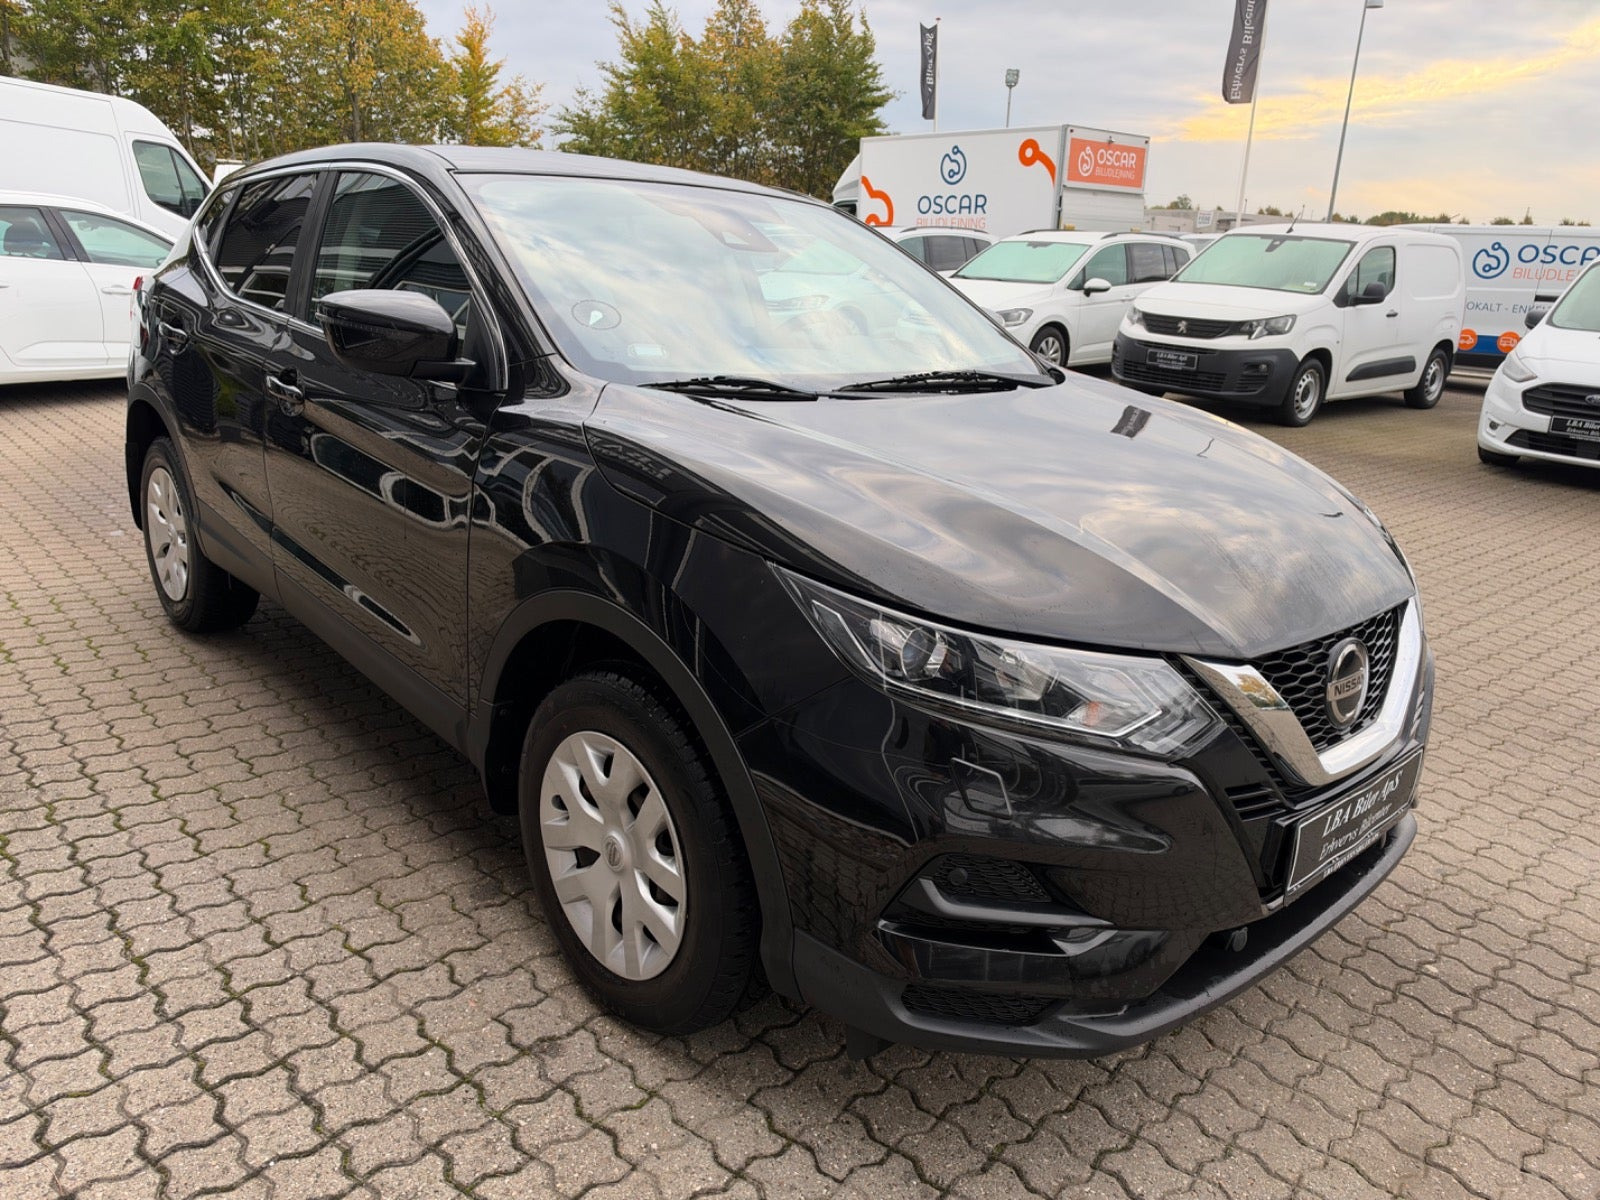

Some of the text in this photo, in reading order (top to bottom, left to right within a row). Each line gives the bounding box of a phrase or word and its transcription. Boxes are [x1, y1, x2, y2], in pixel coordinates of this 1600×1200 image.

[1097, 149, 1137, 169] OSCAR
[917, 194, 988, 215] OSCAR
[1517, 244, 1600, 266] OSCA
[1466, 301, 1504, 313] OKALT
[1322, 803, 1352, 838] LBA
[1351, 791, 1380, 820] Biler
